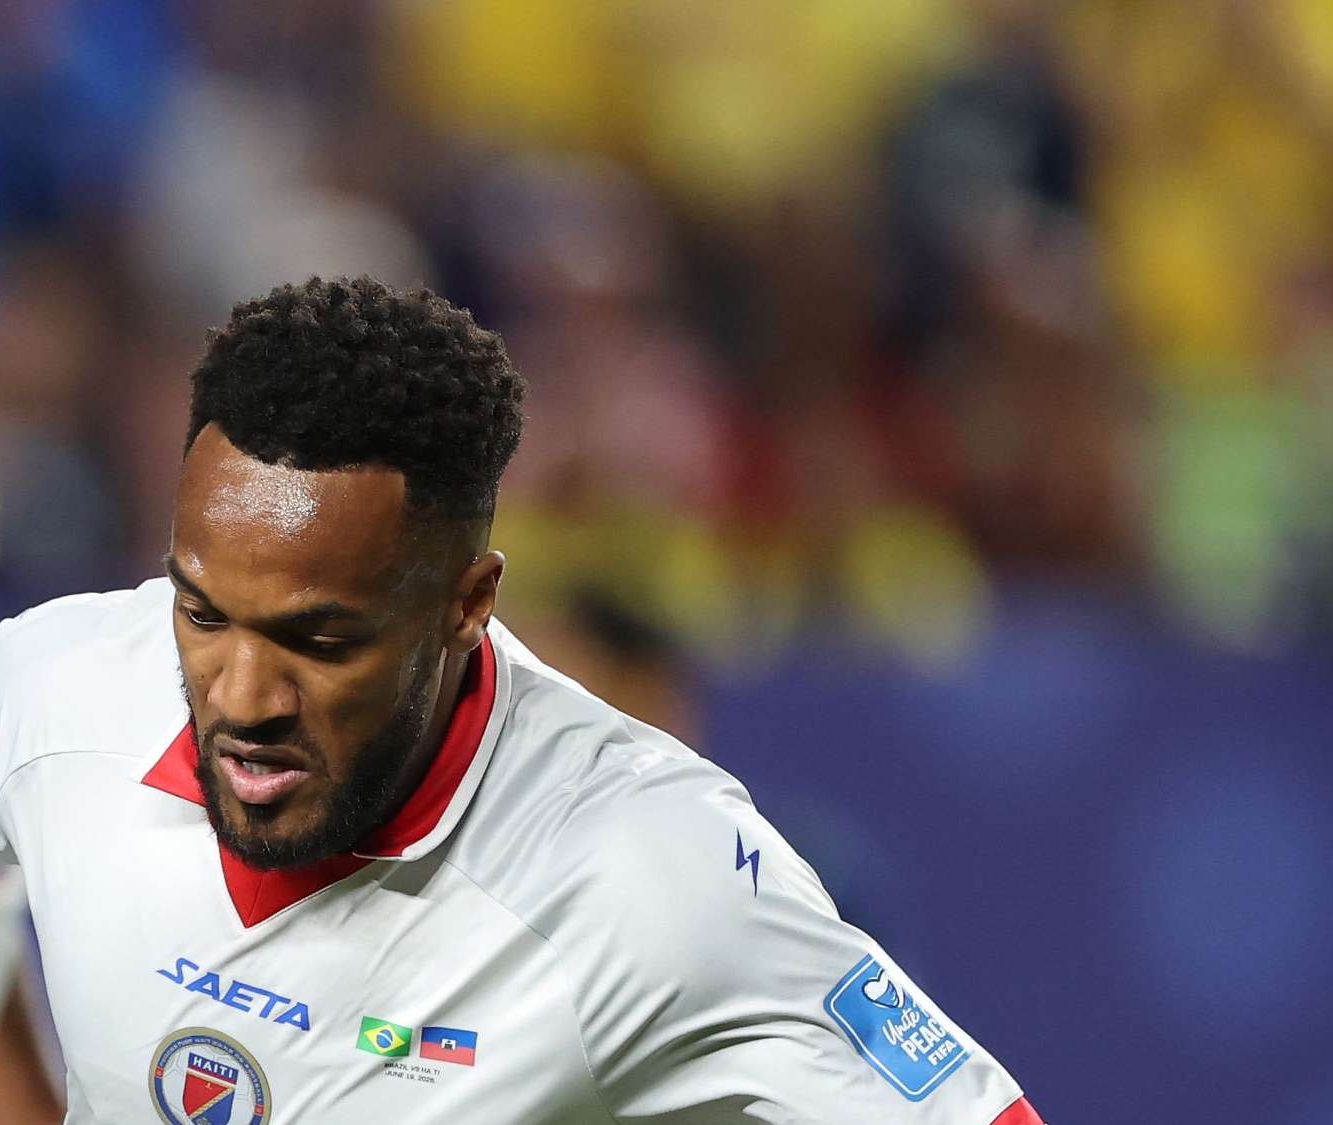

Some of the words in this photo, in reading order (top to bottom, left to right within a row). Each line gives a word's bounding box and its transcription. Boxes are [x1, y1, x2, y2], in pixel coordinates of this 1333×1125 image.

[156, 957, 311, 1032] SAETA
[882, 1007, 920, 1046] Unite
[900, 1018, 947, 1062] PEAC
[192, 1056, 234, 1079] HAITI
[927, 1039, 957, 1067] FIFA
[421, 1066, 440, 1076] HATI
